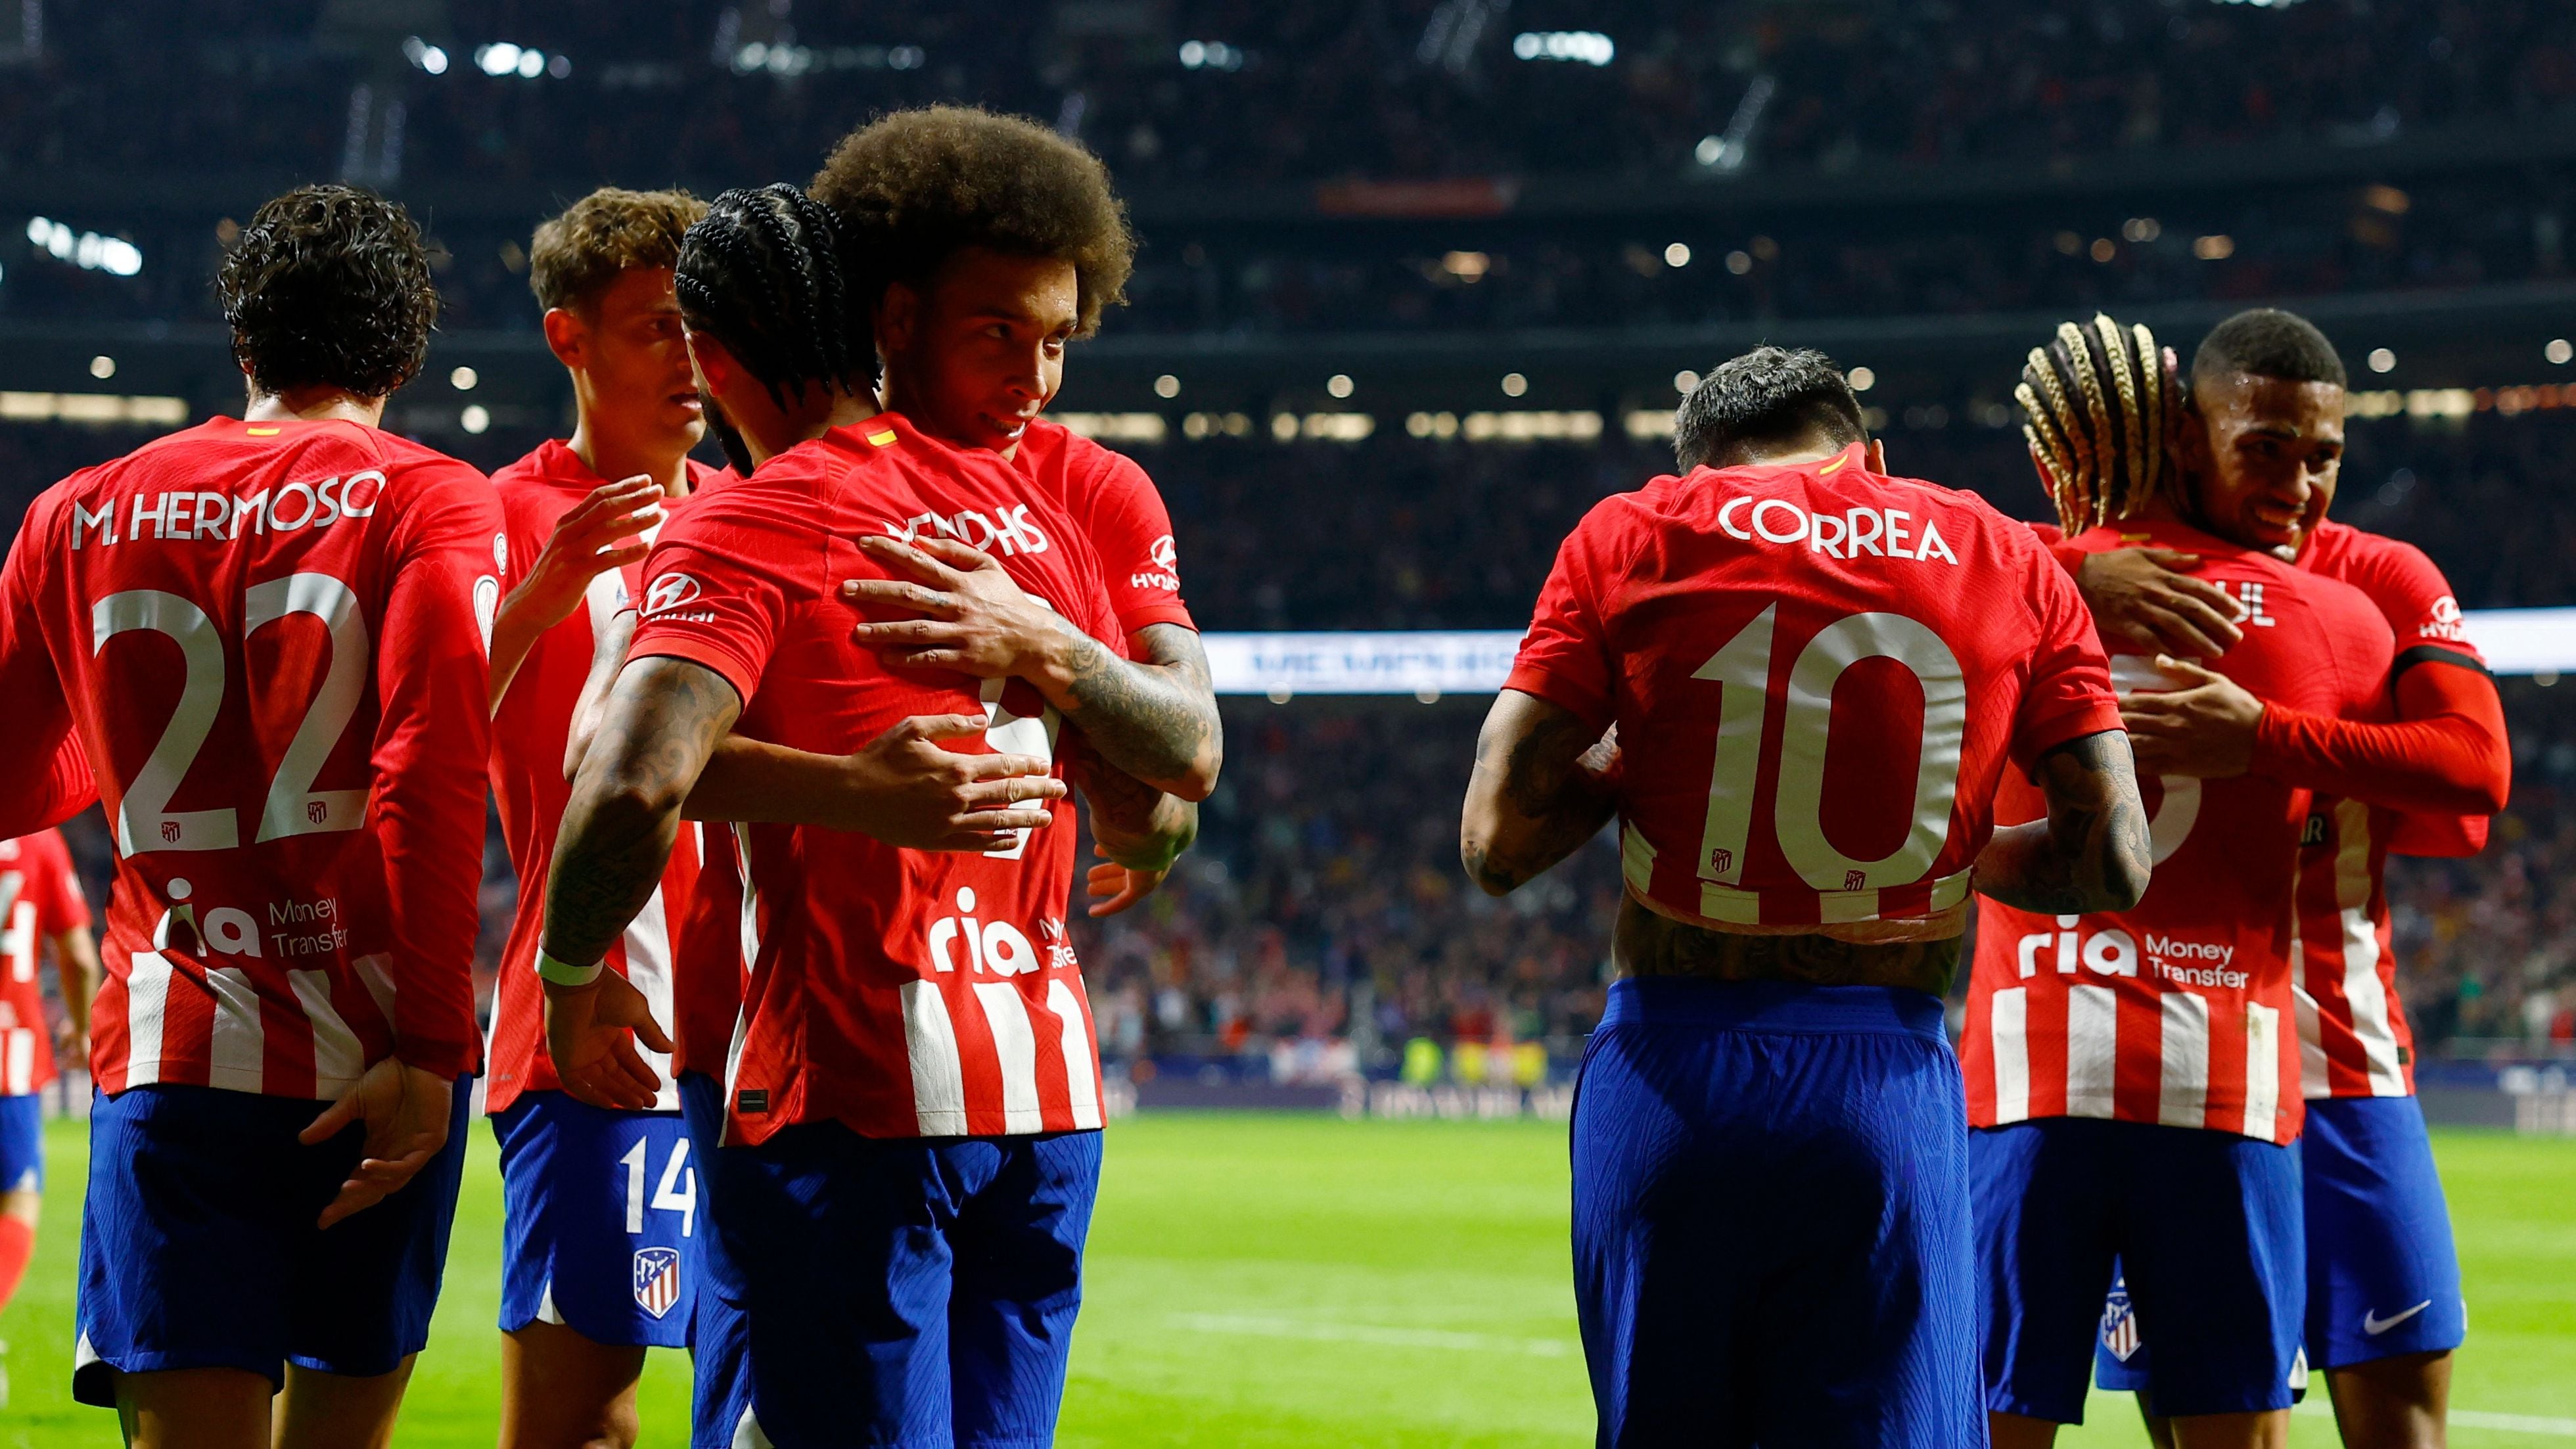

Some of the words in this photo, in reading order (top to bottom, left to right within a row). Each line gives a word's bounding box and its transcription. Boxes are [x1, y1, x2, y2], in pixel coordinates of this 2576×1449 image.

[72, 499, 118, 550] M.
[130, 470, 387, 541] HERMOSO
[1718, 495, 1958, 565] CORREA
[92, 572, 369, 860] 22
[1690, 600, 1966, 891] 10
[269, 897, 336, 925] Money
[271, 923, 348, 957] Transfer
[929, 886, 1040, 977] ria
[2017, 914, 2138, 980] ria
[2145, 933, 2234, 964] Money
[2147, 955, 2249, 990] Transfer
[620, 1135, 697, 1237] 14
